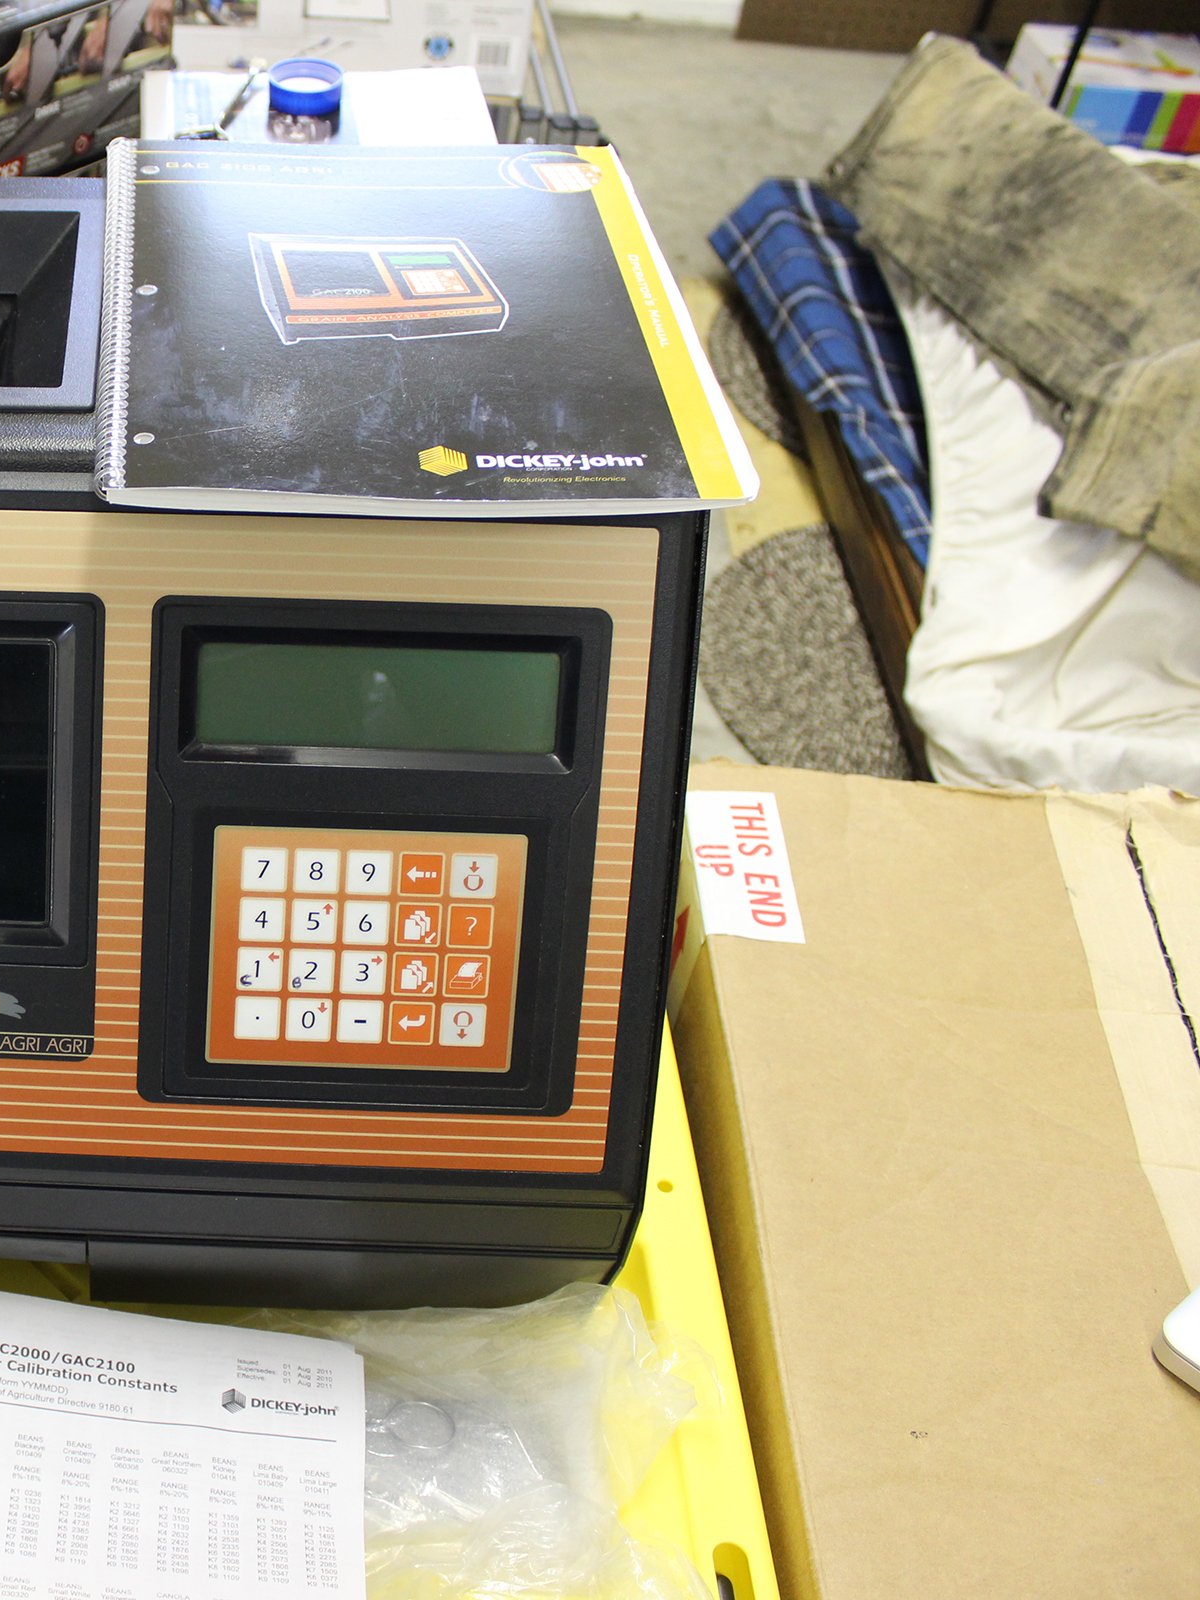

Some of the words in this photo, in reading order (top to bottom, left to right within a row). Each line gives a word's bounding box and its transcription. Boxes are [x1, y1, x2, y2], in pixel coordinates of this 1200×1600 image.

[356, 313, 420, 321] ANALYSIS
[427, 308, 495, 318] COMPUTER
[503, 476, 572, 484] Revolutionizing
[575, 475, 626, 483] Electronics
[730, 802, 773, 856] THIS
[694, 845, 735, 877] UP
[257, 859, 270, 879] 7
[309, 861, 324, 881] 8
[361, 863, 376, 882] 9
[743, 872, 787, 927] END
[254, 910, 269, 929] 4
[306, 911, 320, 931] 5
[358, 913, 373, 933] 6
[464, 916, 478, 936] ?
[253, 960, 261, 978] 1
[303, 961, 318, 981] 2
[355, 962, 370, 982] 3
[301, 1009, 316, 1029] 0
[0, 1035, 41, 1051] AGRI
[45, 1037, 87, 1053] AGRI
[298, 1365, 311, 1374] Aug
[7, 1360, 92, 1383] Calibration
[97, 1373, 178, 1393] Constants
[298, 1372, 311, 1381] Aug
[21, 1380, 69, 1395] YYMMDD)
[298, 1379, 311, 1388] Aug
[7, 1389, 55, 1404] Agriculture
[57, 1396, 96, 1409] Directive
[18, 1433, 44, 1443] BEANS
[66, 1440, 92, 1449] BEANS
[115, 1447, 140, 1455] BEANS
[163, 1451, 189, 1459] BEANS
[211, 1457, 237, 1466] BEANS
[14, 1465, 40, 1474] RANGE
[258, 1464, 284, 1472] BEANS
[63, 1471, 90, 1481] RANGE
[305, 1470, 331, 1479] BEANS
[112, 1477, 139, 1486] RANGE
[161, 1482, 188, 1491] RANGE
[300, 1477, 317, 1485] Lima
[318, 1480, 338, 1489] Large
[210, 1488, 236, 1498] RANGE
[257, 1495, 284, 1504] RANGE
[304, 1501, 330, 1510] RANGE
